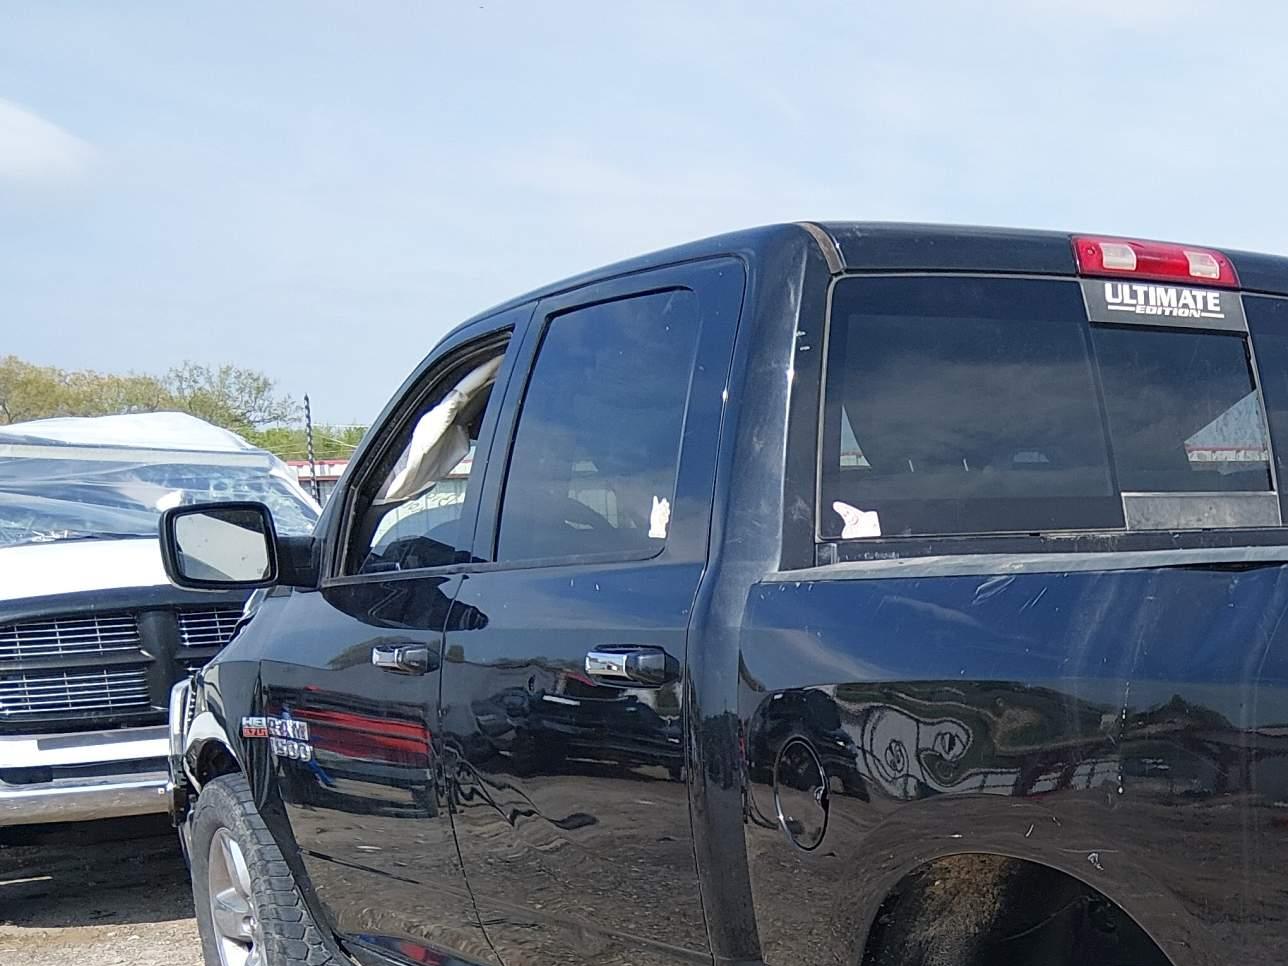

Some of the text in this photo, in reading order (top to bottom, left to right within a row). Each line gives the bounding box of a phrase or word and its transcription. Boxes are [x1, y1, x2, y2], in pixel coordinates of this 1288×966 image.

[1104, 282, 1221, 312] ULTIMATE
[1135, 305, 1202, 318] EDITION
[242, 717, 267, 727] HE
[267, 717, 309, 741] RAM
[269, 737, 312, 762] 1500
